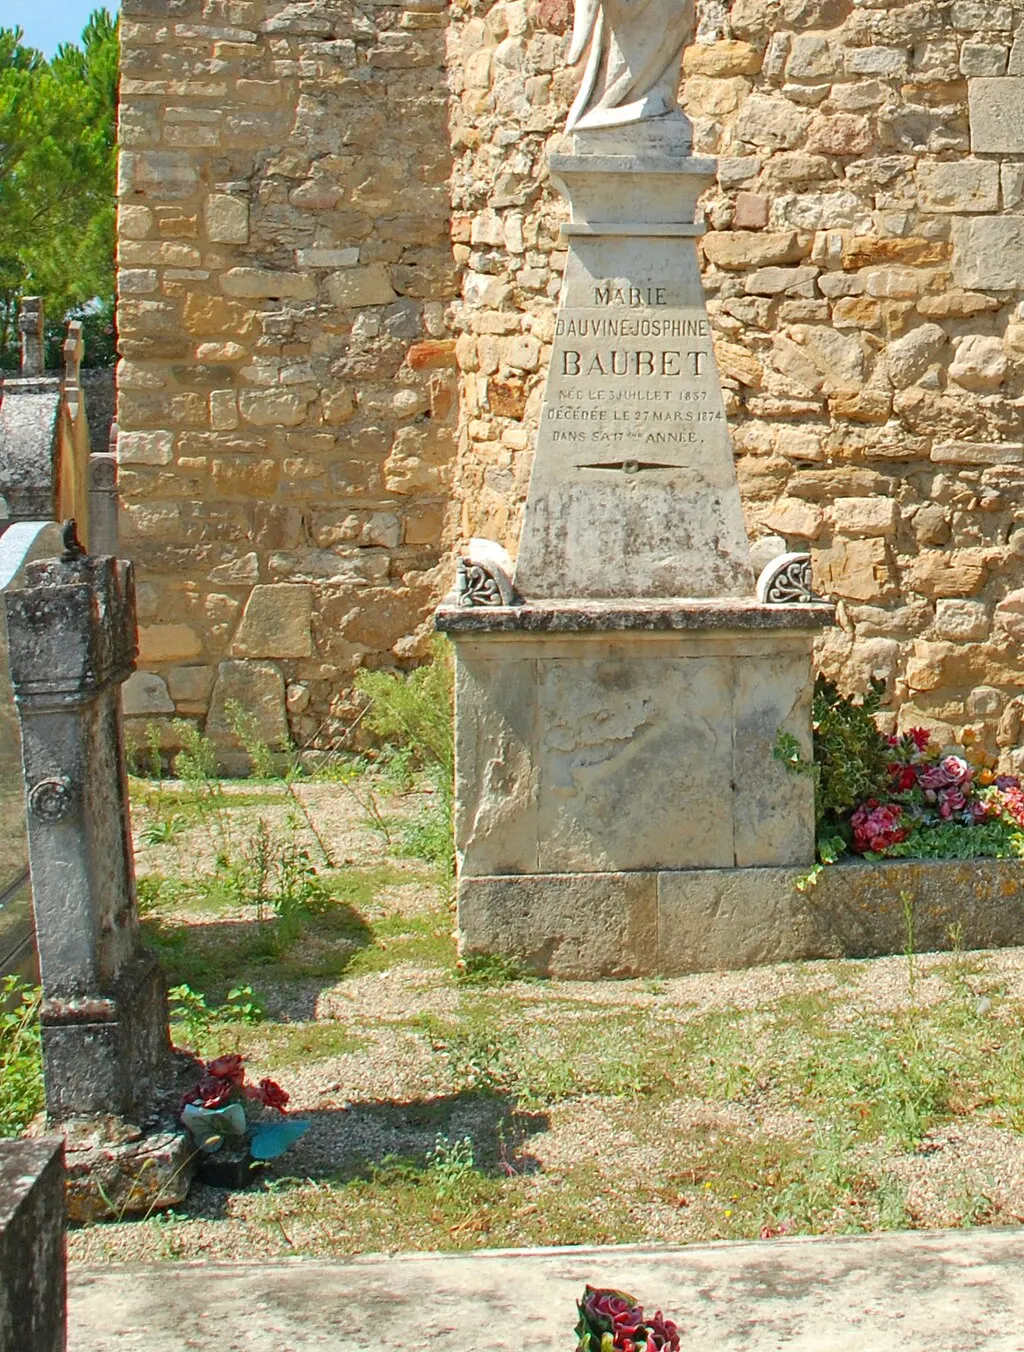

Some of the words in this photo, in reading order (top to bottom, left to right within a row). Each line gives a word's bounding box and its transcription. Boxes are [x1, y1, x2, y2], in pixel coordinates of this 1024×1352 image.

[594, 287, 668, 305] MARIE
[562, 350, 708, 376] BAUBET
[588, 391, 605, 400] LE
[547, 405, 607, 421] DÉCÉDÉE
[614, 411, 629, 420] LE
[652, 411, 693, 421] MARS
[552, 431, 586, 441] DANS
[591, 431, 610, 441] SA
